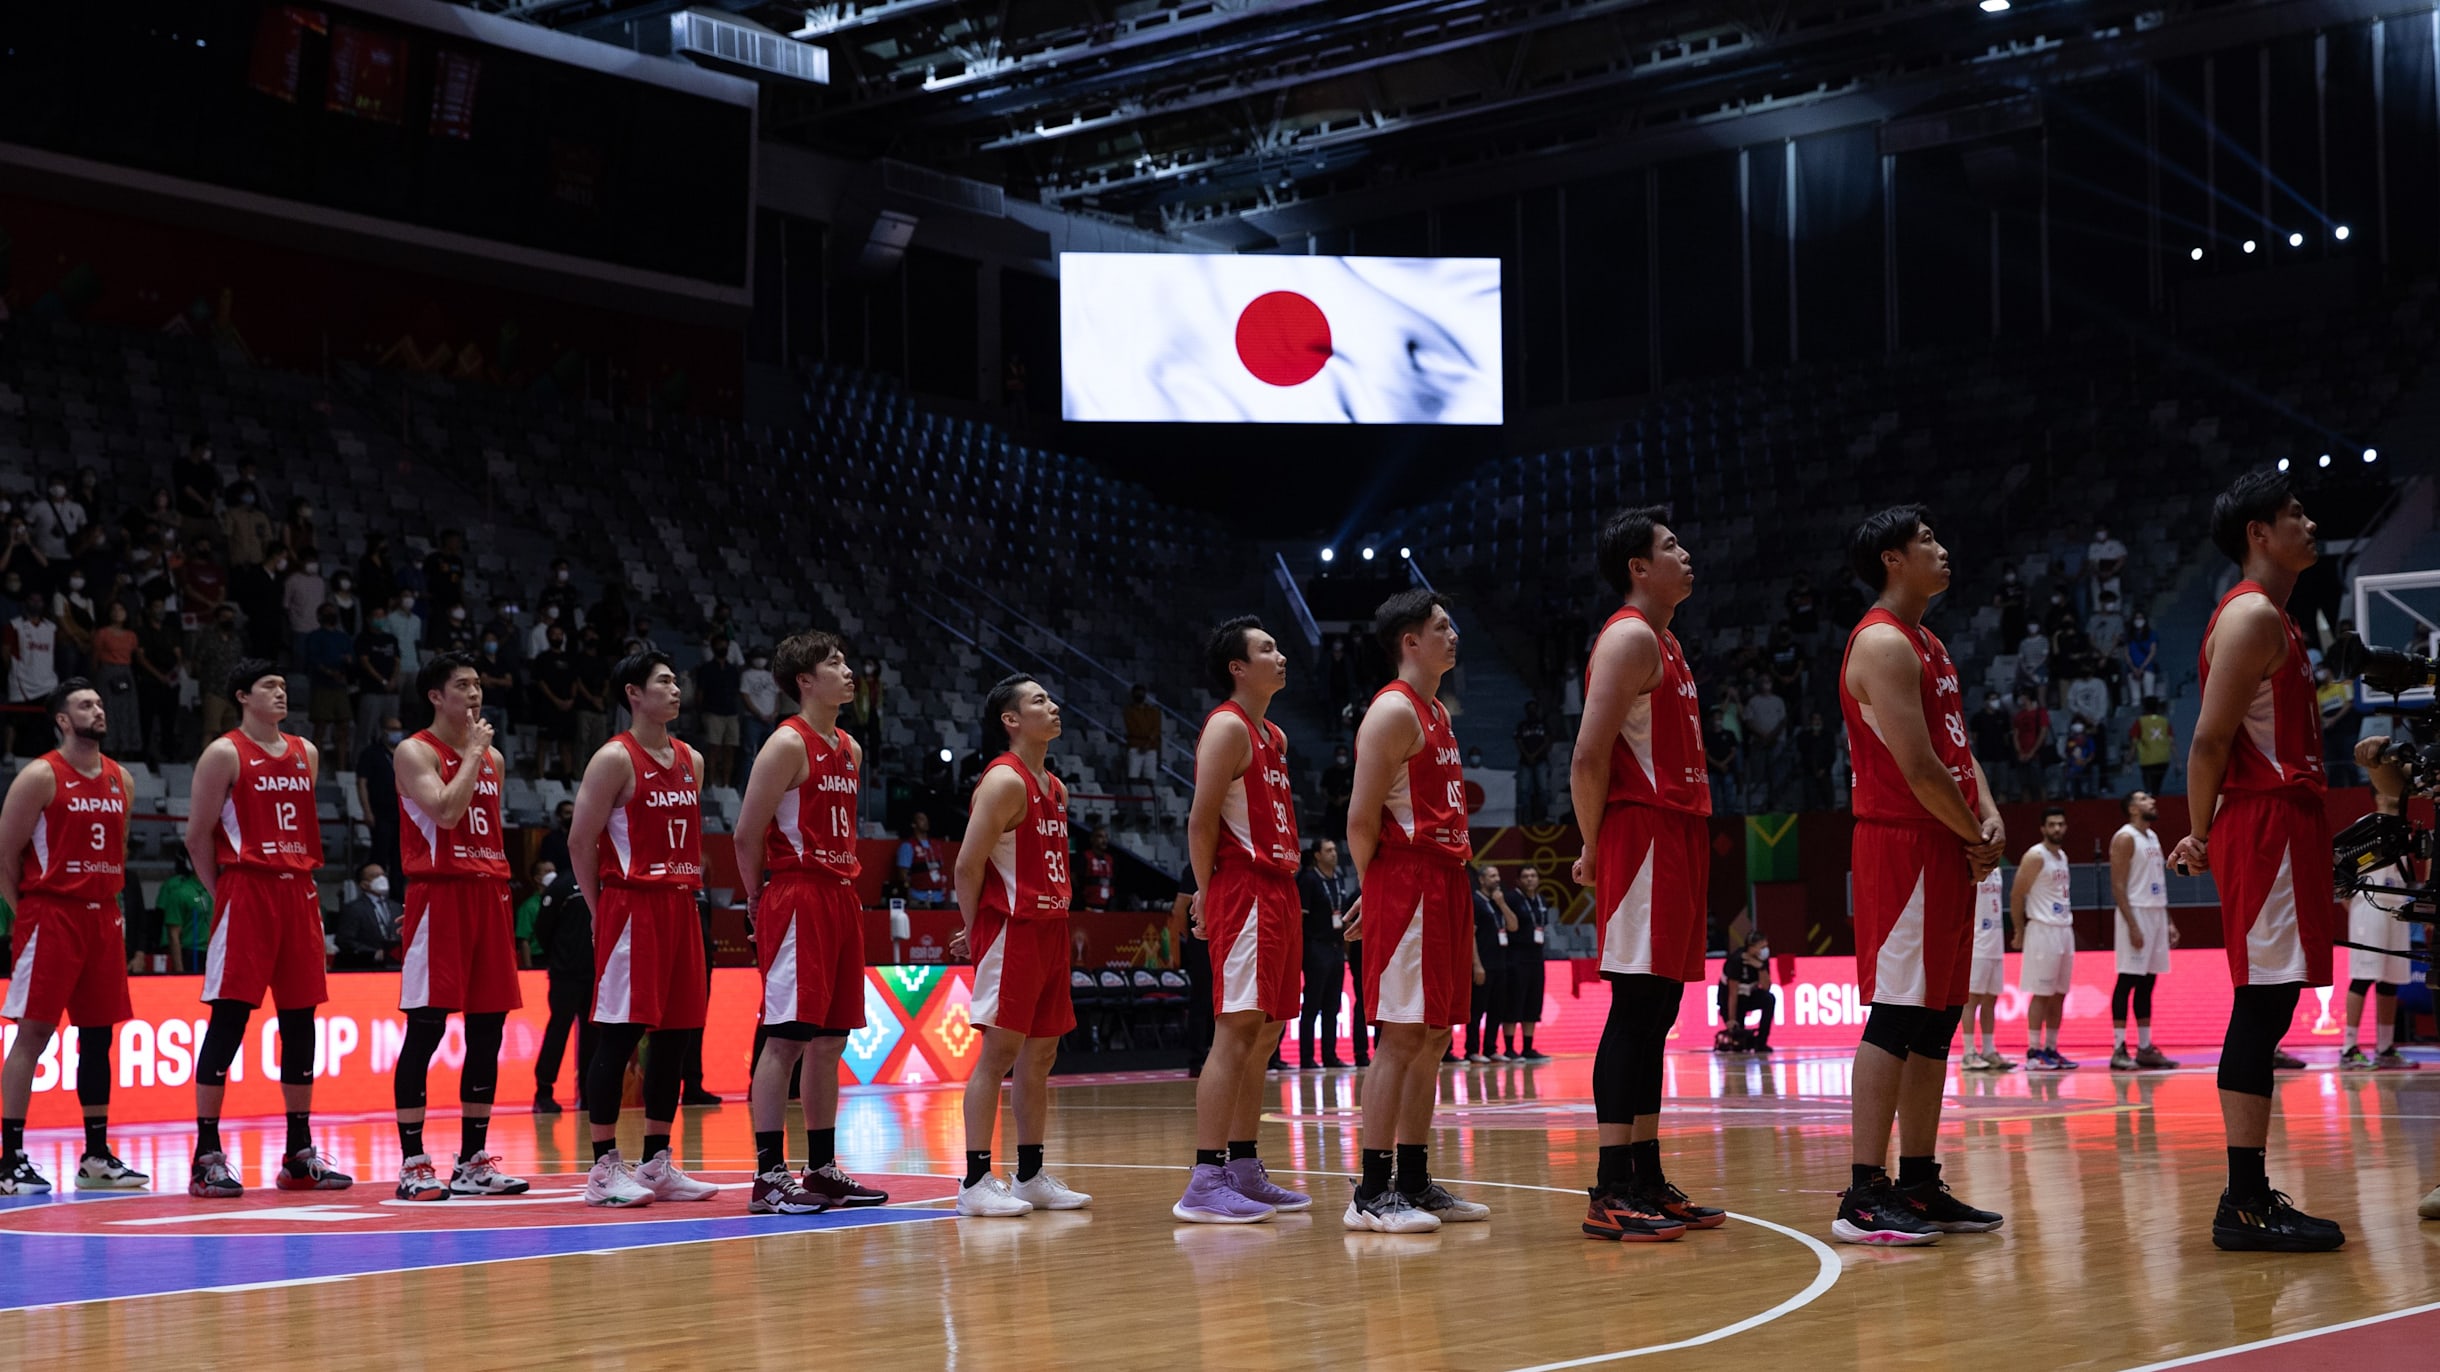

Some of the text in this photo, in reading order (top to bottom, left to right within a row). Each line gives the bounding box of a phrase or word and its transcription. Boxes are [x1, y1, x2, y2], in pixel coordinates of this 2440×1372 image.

[253, 775, 310, 792] JAPAN
[818, 774, 858, 795] JAPAN
[67, 797, 123, 813] JAPAN
[645, 790, 698, 808] JAPAN
[275, 802, 298, 831] 12
[467, 806, 489, 836] 16
[830, 805, 850, 838] 19
[90, 822, 105, 850] 3
[667, 819, 688, 849] 17
[1044, 850, 1067, 884] 33
